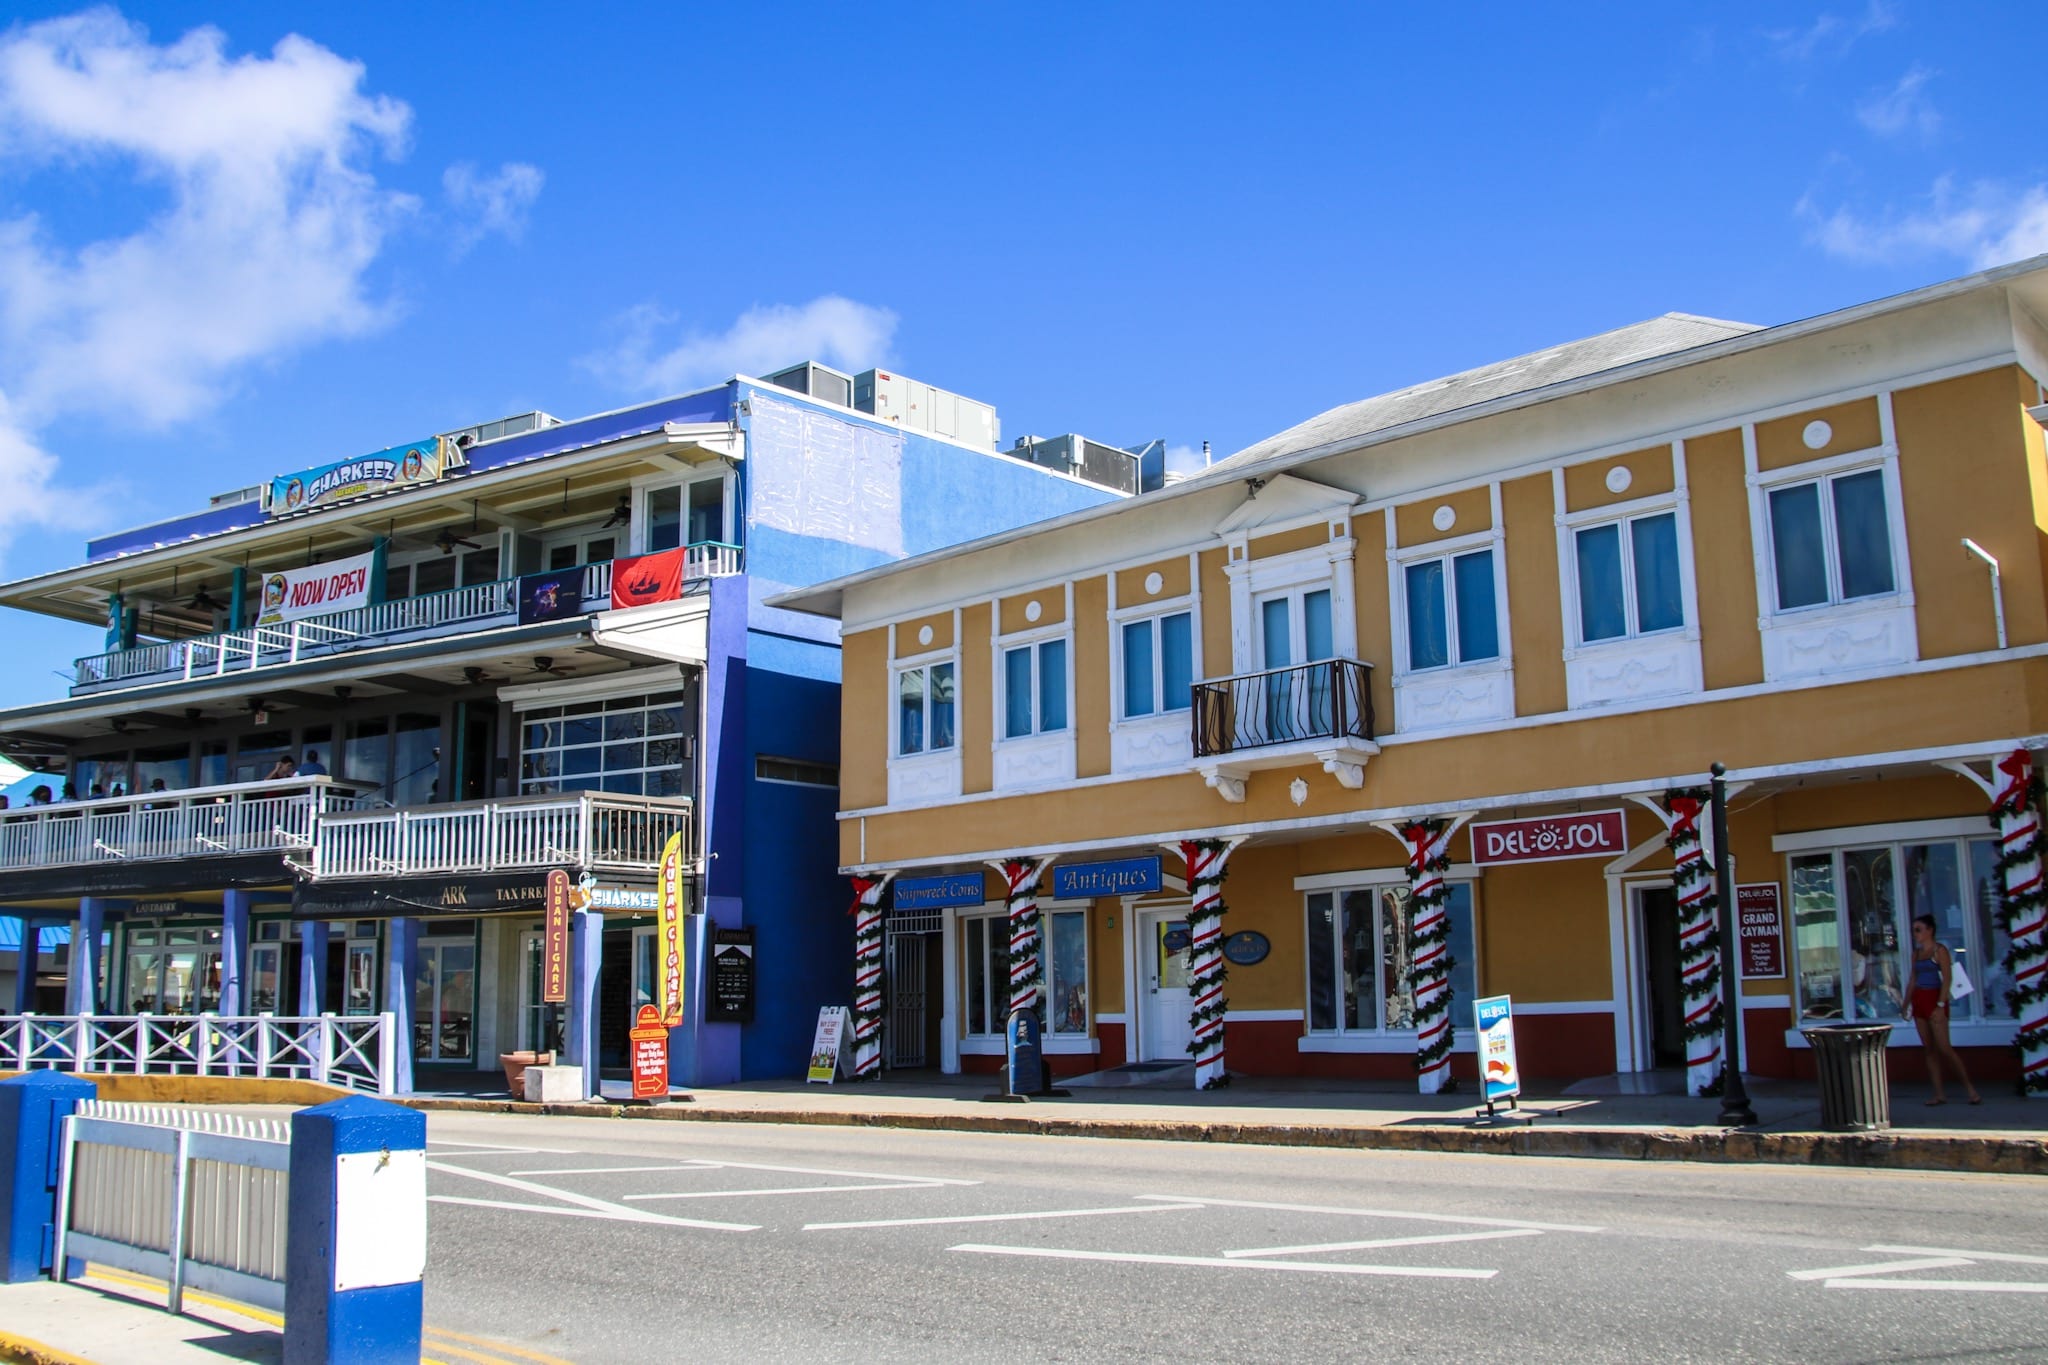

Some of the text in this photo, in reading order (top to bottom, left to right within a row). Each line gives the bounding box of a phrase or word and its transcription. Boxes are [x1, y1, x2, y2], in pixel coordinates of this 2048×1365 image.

[308, 459, 397, 502] SHARKEEZ
[289, 566, 367, 609] NOW OPEN
[1486, 822, 1610, 857] DEL SOL
[441, 885, 467, 905] ARK
[495, 887, 519, 901] TAX
[665, 855, 677, 921] CUBAN
[950, 882, 980, 898] Coins
[1063, 867, 1148, 894] Antiques
[591, 888, 659, 908] SHARKEE
[1740, 926, 1780, 936] CAYMAN
[1742, 912, 1776, 924] GRAND
[551, 874, 563, 994] CUBAN CIGARS
[666, 926, 680, 1006] CIGARS
